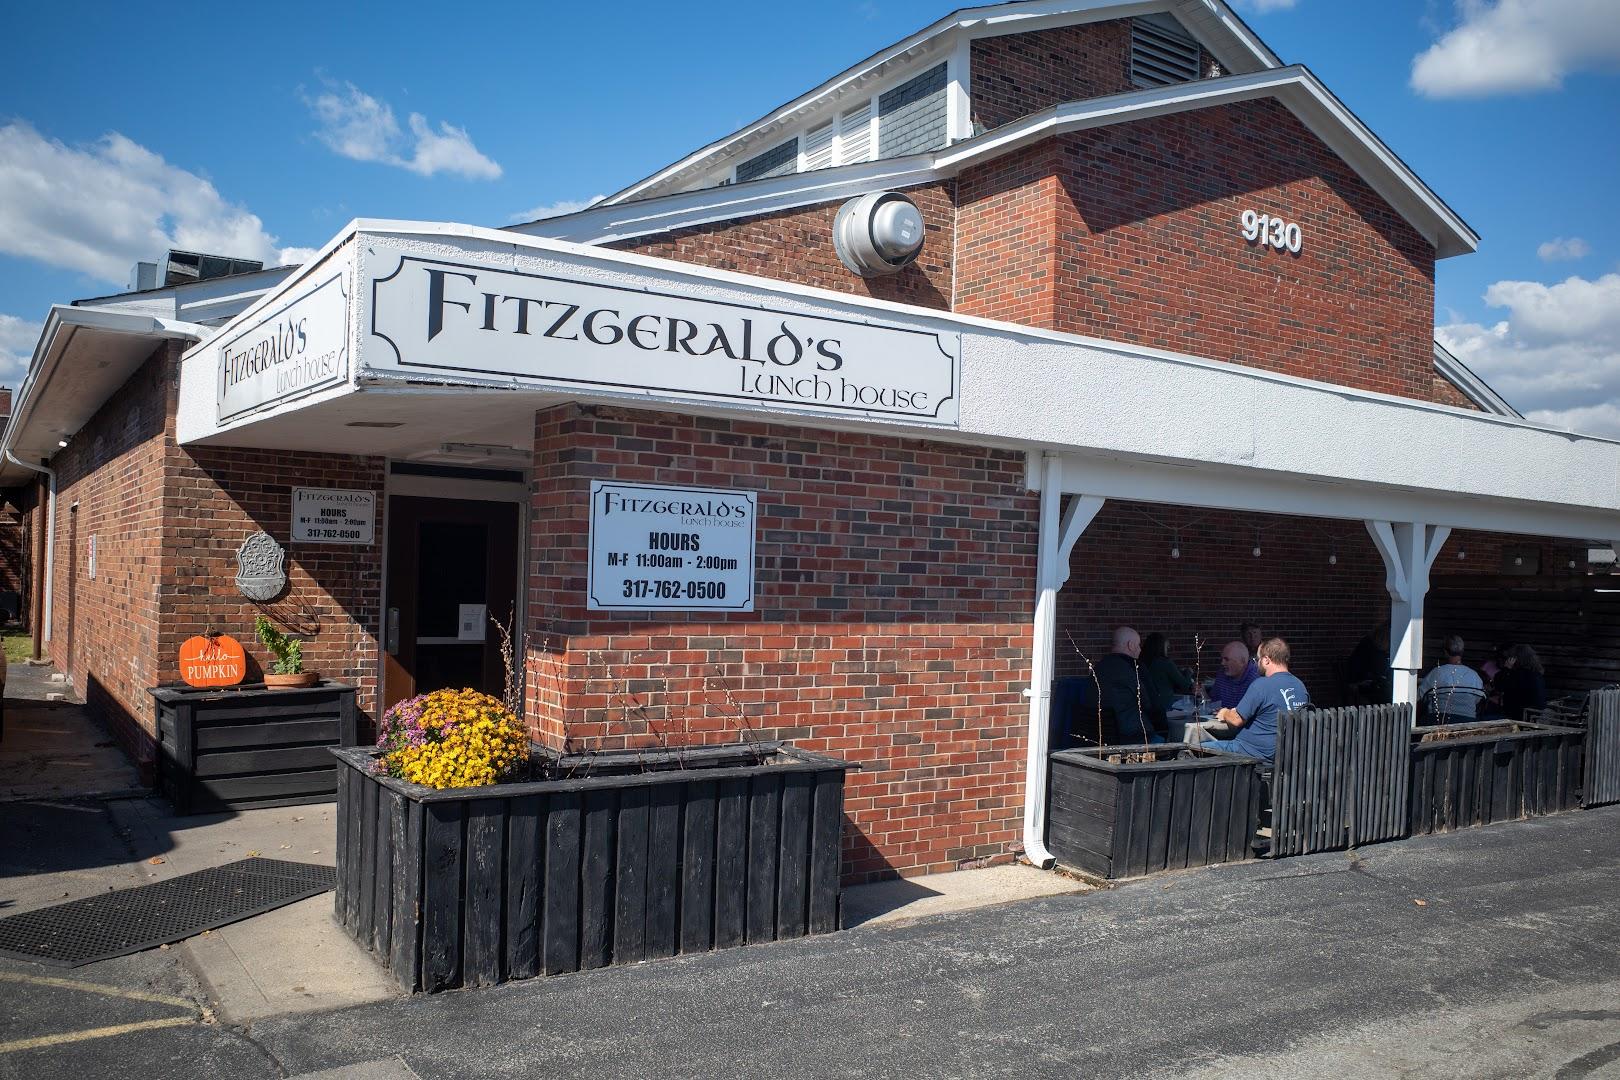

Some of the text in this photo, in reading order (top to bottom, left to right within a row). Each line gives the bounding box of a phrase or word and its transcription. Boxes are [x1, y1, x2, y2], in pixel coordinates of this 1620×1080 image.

[1242, 210, 1301, 252] 9130
[321, 509, 346, 517] HOURS
[308, 529, 359, 538] 317-762-0500
[649, 531, 700, 551] HOURS
[607, 552, 629, 567] M-F
[635, 553, 683, 568] 11:00am
[696, 556, 738, 571] 2:00pm
[622, 579, 726, 600] 317-762-0500
[188, 665, 238, 679] PUMPKIN
